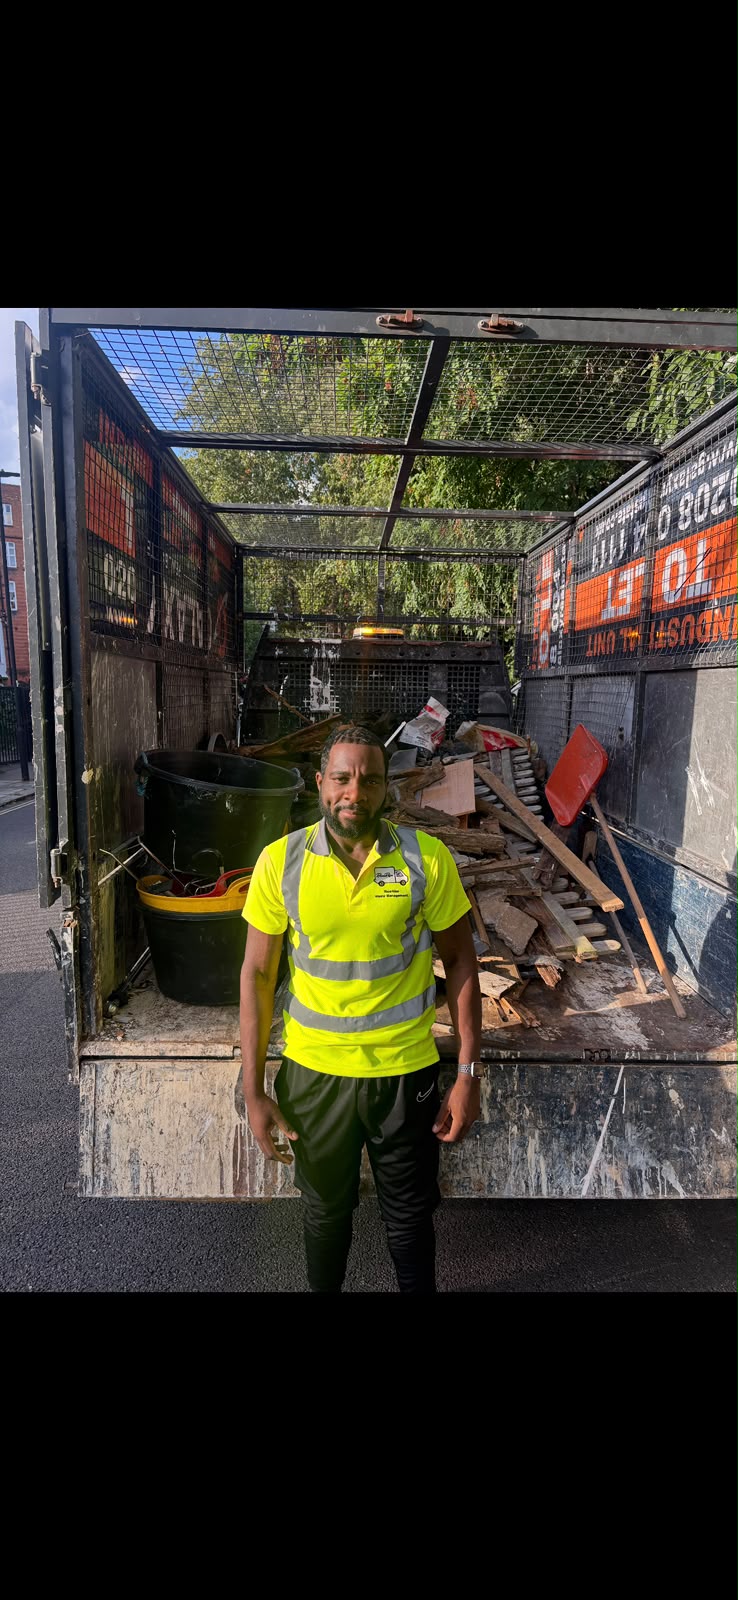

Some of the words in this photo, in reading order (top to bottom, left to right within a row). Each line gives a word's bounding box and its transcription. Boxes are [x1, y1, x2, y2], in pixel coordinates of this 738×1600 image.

[632, 504, 671, 552] 04
[661, 538, 712, 604] TO
[586, 630, 616, 657] UNIT
[619, 601, 738, 654] INDUSTAL
